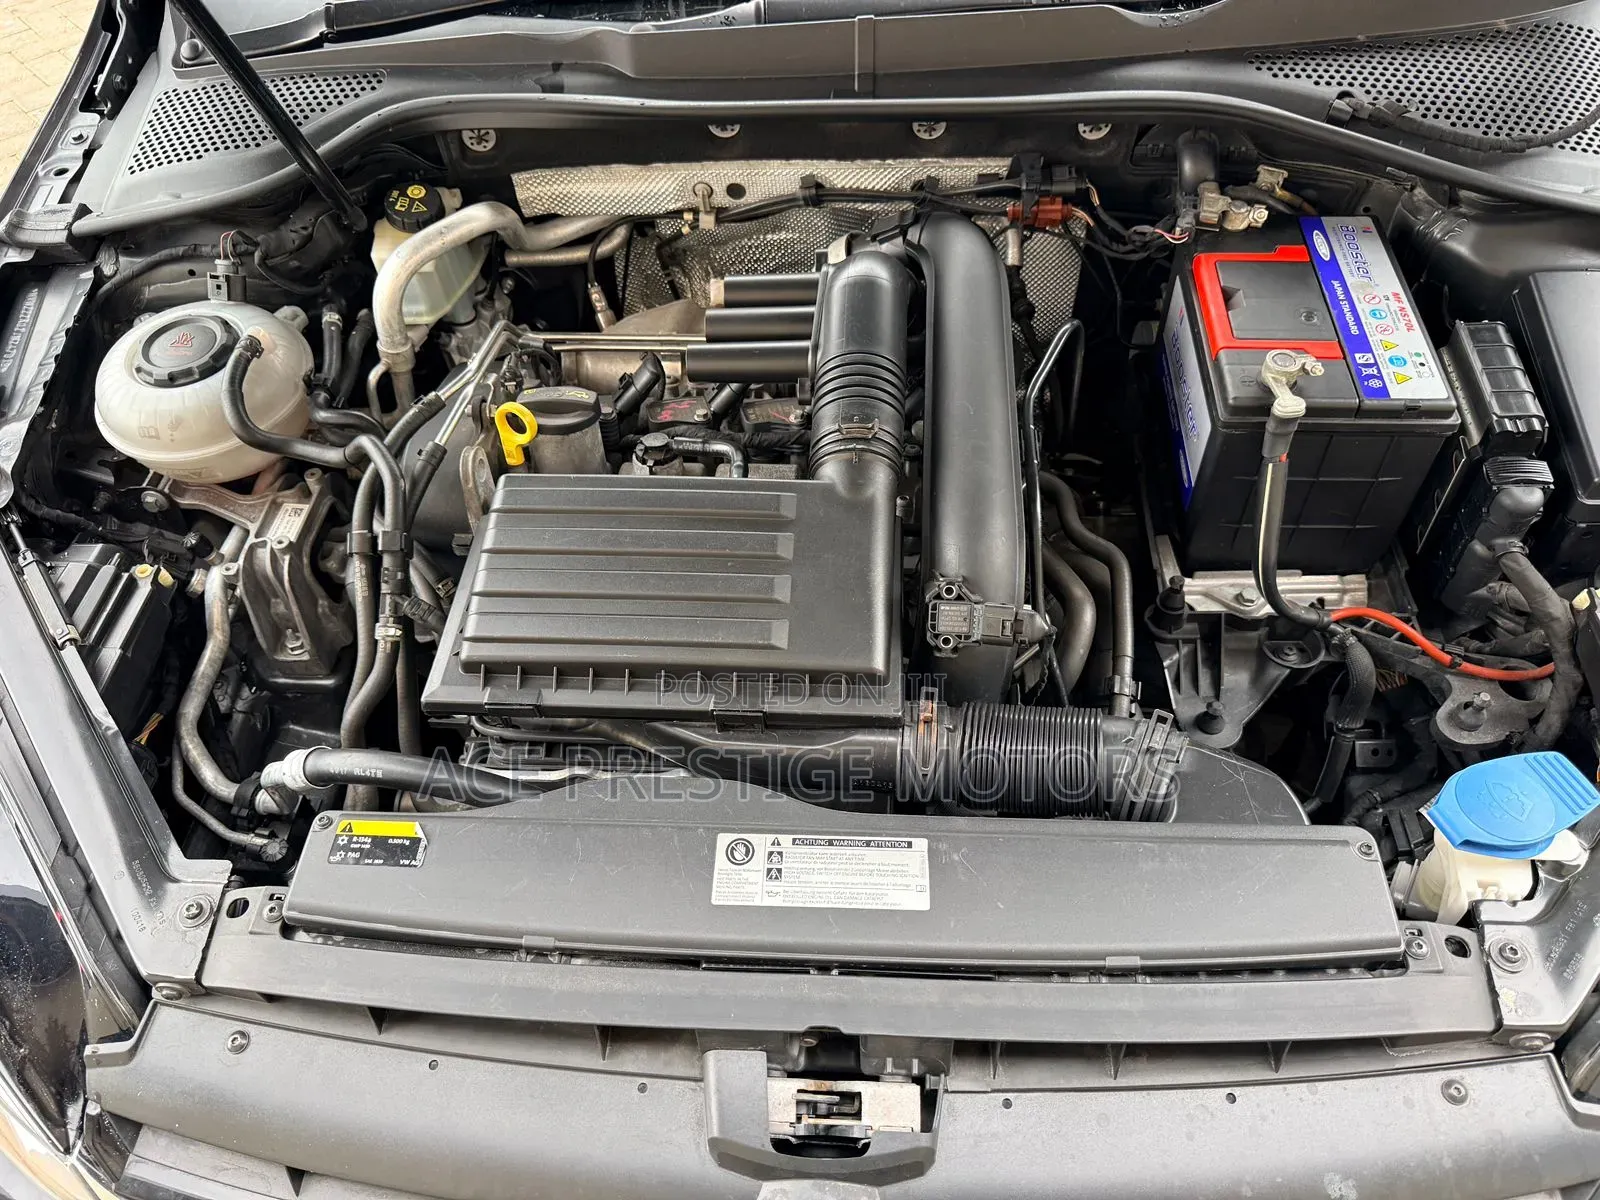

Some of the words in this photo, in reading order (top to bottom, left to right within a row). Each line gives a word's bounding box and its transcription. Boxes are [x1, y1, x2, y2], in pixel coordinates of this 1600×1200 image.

[1338, 224, 1373, 284] Booster
[1333, 281, 1344, 299] JAPAN
[1341, 298, 1359, 335] STANDARD
[1392, 291, 1404, 308] MF
[1398, 305, 1416, 332] NS70L
[795, 838, 829, 846] ACHTUNG
